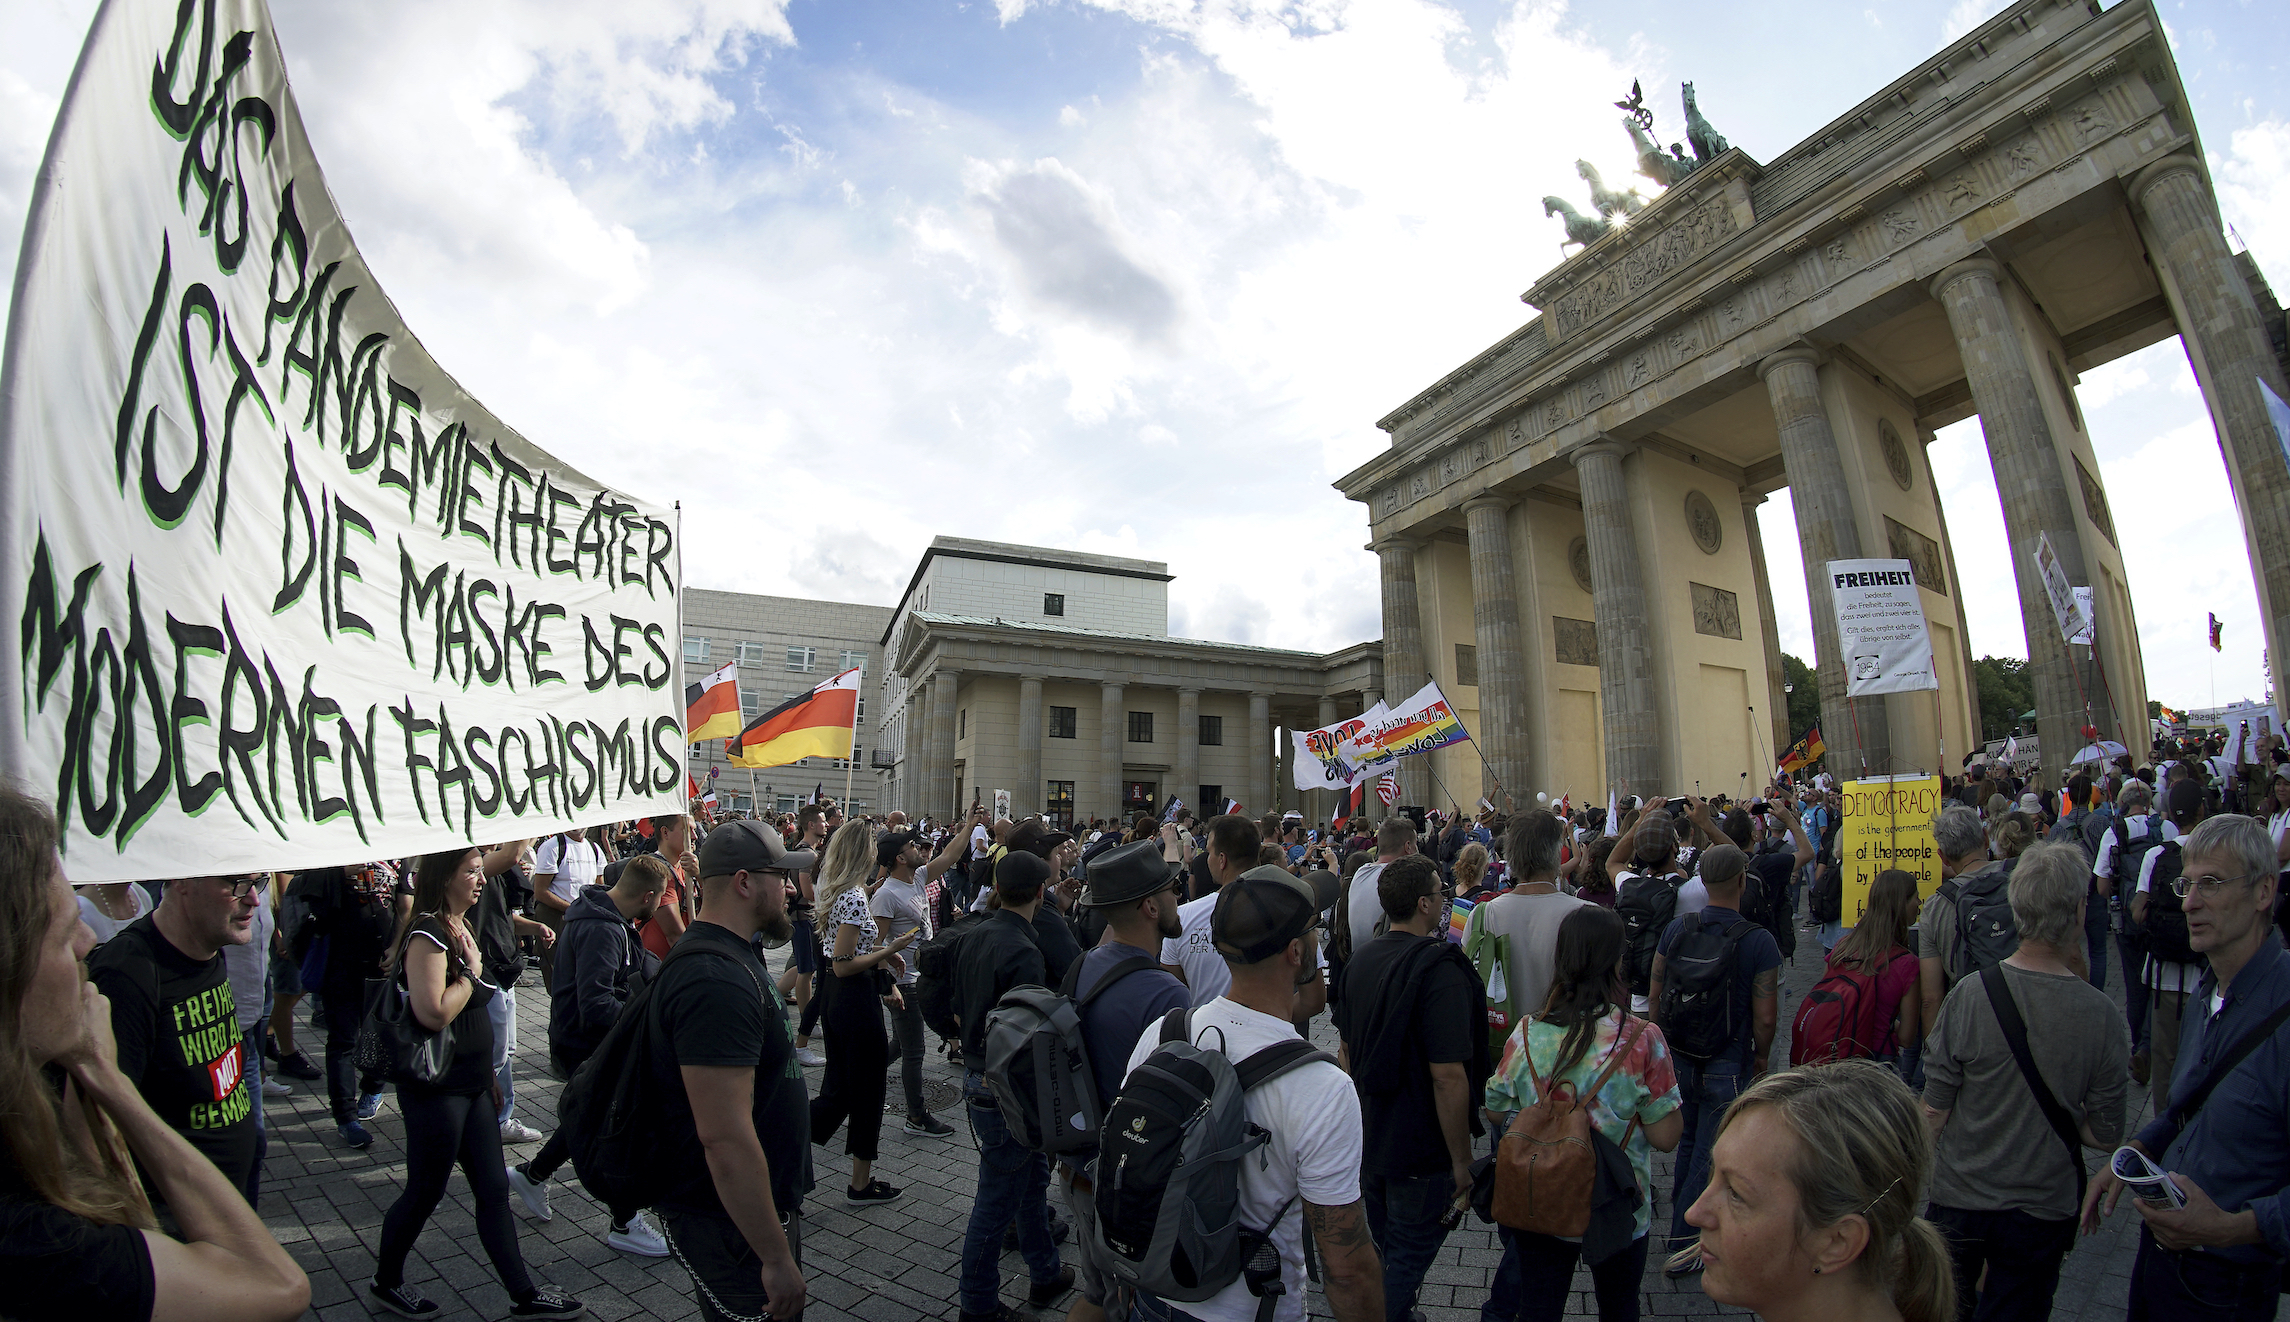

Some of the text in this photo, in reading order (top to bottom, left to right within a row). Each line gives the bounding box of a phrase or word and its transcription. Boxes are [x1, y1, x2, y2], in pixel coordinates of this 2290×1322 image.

[258, 180, 674, 600] PANDEMIETHEATER
[115, 226, 671, 693] IST DIE MASKE DES
[1833, 571, 1911, 589] FREIHEIT
[21, 516, 682, 857] MODERNEN FASCHISMUS
[1842, 788, 1940, 818] DEMOCRACY
[1857, 819, 1932, 837] is the government
[1856, 838, 1932, 863] of the people
[1856, 866, 1868, 885] by
[178, 1021, 227, 1067] WIRD
[215, 1046, 239, 1097] MUT
[1121, 1129, 1150, 1146] deuter
